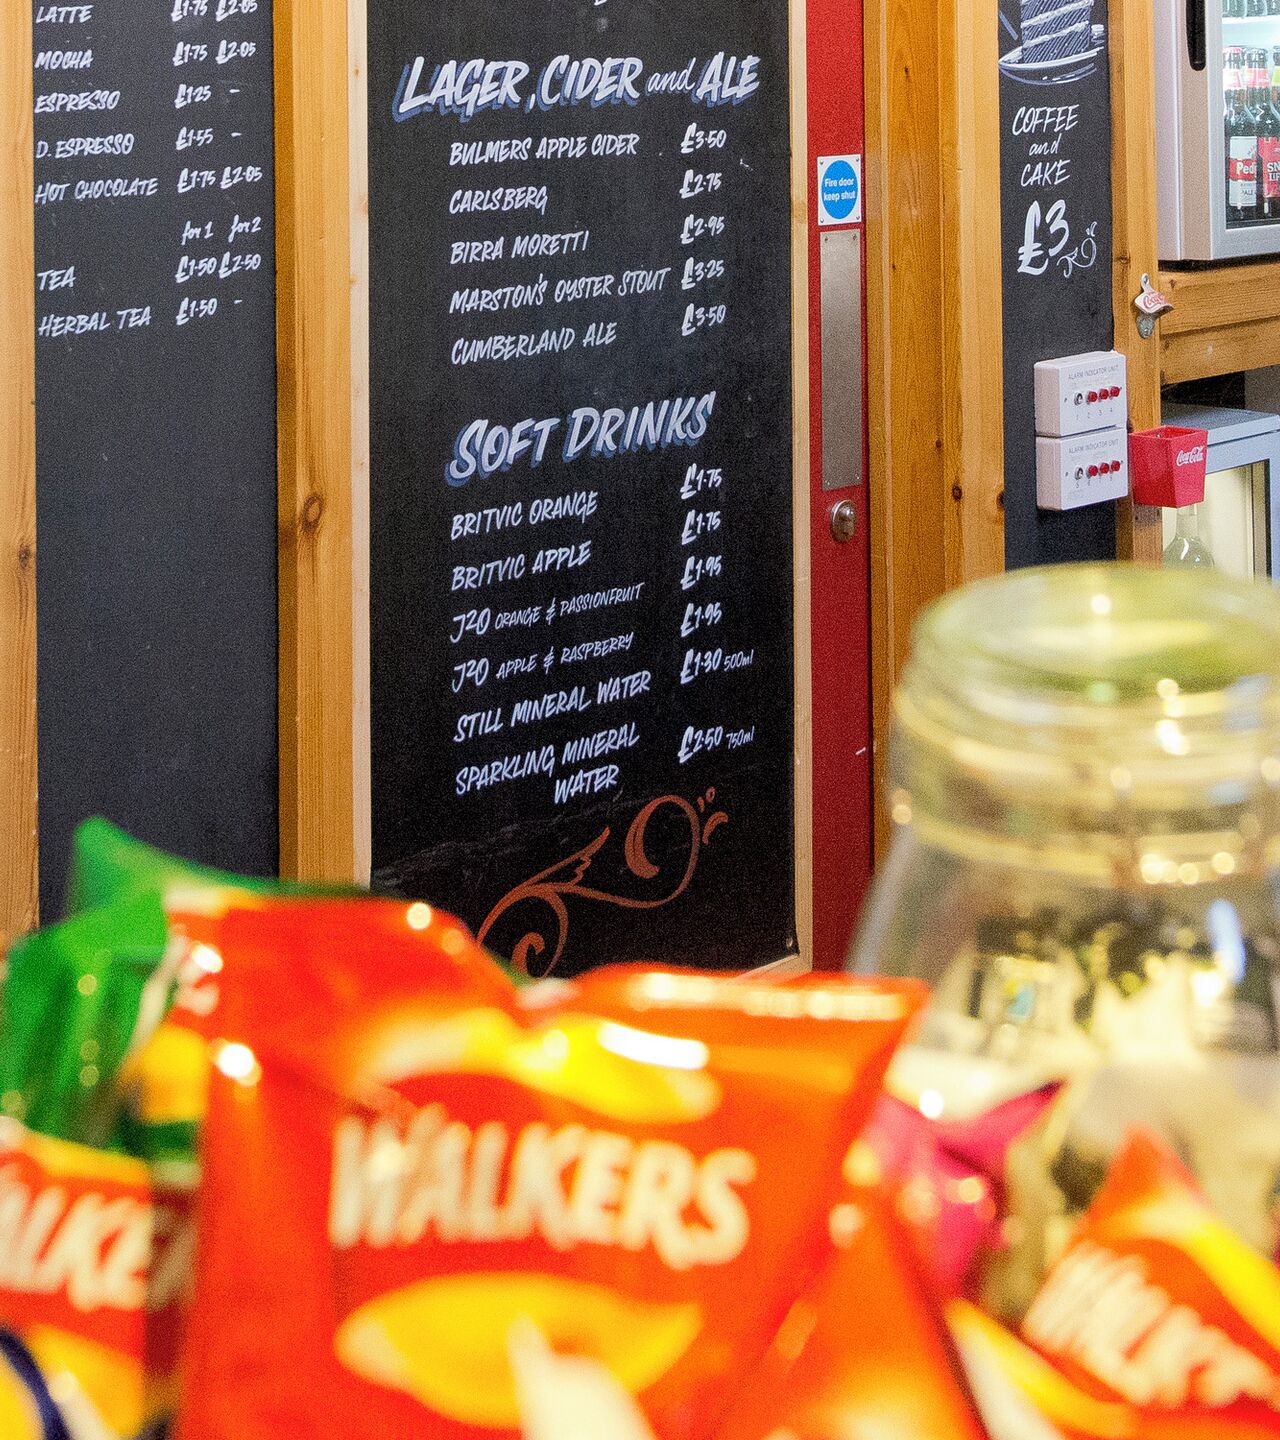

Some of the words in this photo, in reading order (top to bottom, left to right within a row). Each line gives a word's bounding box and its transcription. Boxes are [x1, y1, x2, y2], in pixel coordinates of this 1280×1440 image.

[36, 5, 93, 23] LATTE
[35, 50, 93, 69] MOCHA
[173, 41, 207, 66] £1.75
[216, 40, 256, 64] £2.05
[35, 90, 120, 113] ESPRESSO
[537, 54, 643, 111] CIDER
[647, 58, 696, 96] and
[695, 52, 761, 108] ALE
[1012, 104, 1079, 136] COFFEE
[36, 140, 52, 159] D.
[55, 133, 134, 158] ESPRESSO
[176, 127, 213, 150] £1.55
[449, 138, 532, 166] BULMERS
[536, 136, 587, 159] APPLE
[592, 134, 640, 157] CIDER
[680, 123, 727, 154] £3.50
[1029, 134, 1060, 155] and
[35, 183, 70, 204] HOT
[75, 178, 158, 201] CHOCOLATE
[177, 168, 216, 193] £1.75
[221, 166, 262, 190] £2.05
[449, 185, 548, 215] CARLSBERG
[679, 169, 722, 199] £2.75
[824, 192, 840, 202] keep
[841, 191, 855, 200] shut
[825, 179, 837, 187] Fire
[839, 178, 854, 187] door
[1020, 160, 1071, 189] CAKE
[450, 237, 504, 265] BIRRA
[511, 231, 590, 258] MORETTI
[680, 214, 725, 244] £2.95
[1017, 199, 1070, 276] £3
[37, 267, 76, 290] TEA
[175, 256, 217, 283] £1.50
[219, 252, 261, 279] £2.50
[449, 274, 547, 314] MARSTON'S
[555, 275, 613, 304] OYSTER
[618, 267, 672, 297] STOUT
[680, 257, 725, 290] £3.25
[39, 313, 110, 336] HERBAL
[118, 306, 152, 329] TEA
[176, 297, 217, 325] £1.50
[451, 327, 576, 365] CUMBERLAND
[583, 322, 618, 347] ALE
[681, 303, 726, 336] £3.50
[445, 418, 560, 486] SOFT
[564, 391, 717, 462] DRINKS
[451, 502, 522, 540] BRITVIC
[528, 491, 599, 526] ORANGE
[680, 463, 722, 501] £1.75
[451, 554, 525, 591] BRITVIC
[532, 540, 592, 575] APPLE
[681, 510, 721, 546] £1.75
[450, 610, 490, 643] J2O
[494, 606, 541, 630] ORANGE
[545, 597, 556, 624] &
[560, 582, 645, 616] PASSIONFRUIT
[680, 556, 722, 591] £1.95
[452, 659, 489, 693] J2O
[496, 655, 537, 680] APPLE
[544, 646, 554, 672] &
[561, 632, 635, 663] RASPBERRY
[680, 602, 721, 637] £1.95
[453, 711, 504, 742] STILL
[510, 690, 592, 726] MINERAL
[597, 671, 652, 703] WATER
[680, 648, 721, 684] £1.30
[724, 650, 754, 671] 500ml
[456, 750, 555, 796] SPARKLING
[562, 722, 640, 764] MINERAL
[678, 726, 723, 763] £2.50
[725, 726, 755, 750] 750ml
[554, 765, 620, 805] WATER
[328, 1108, 758, 1271] WALKERS
